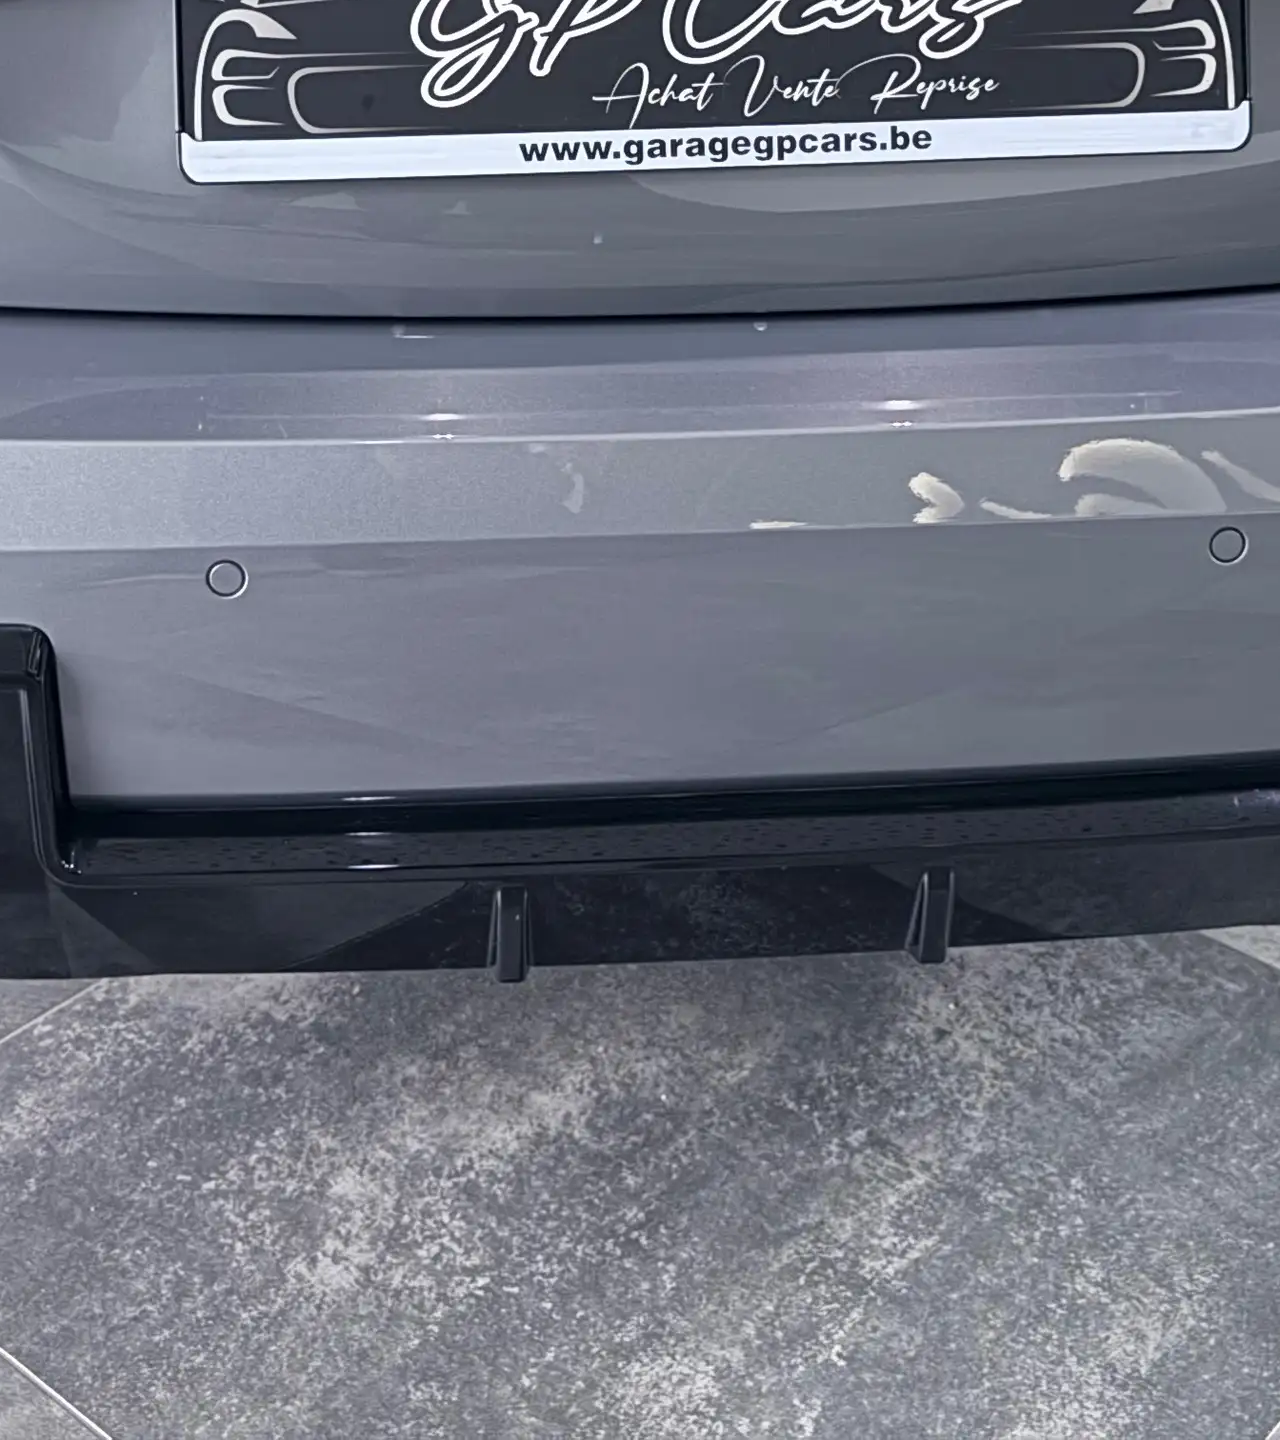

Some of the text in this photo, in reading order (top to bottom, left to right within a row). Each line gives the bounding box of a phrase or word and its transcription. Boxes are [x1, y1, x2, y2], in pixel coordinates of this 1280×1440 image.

[592, 53, 1001, 129] Achat Vente Reprise
[519, 125, 933, 166] www.garagegpcars.be
